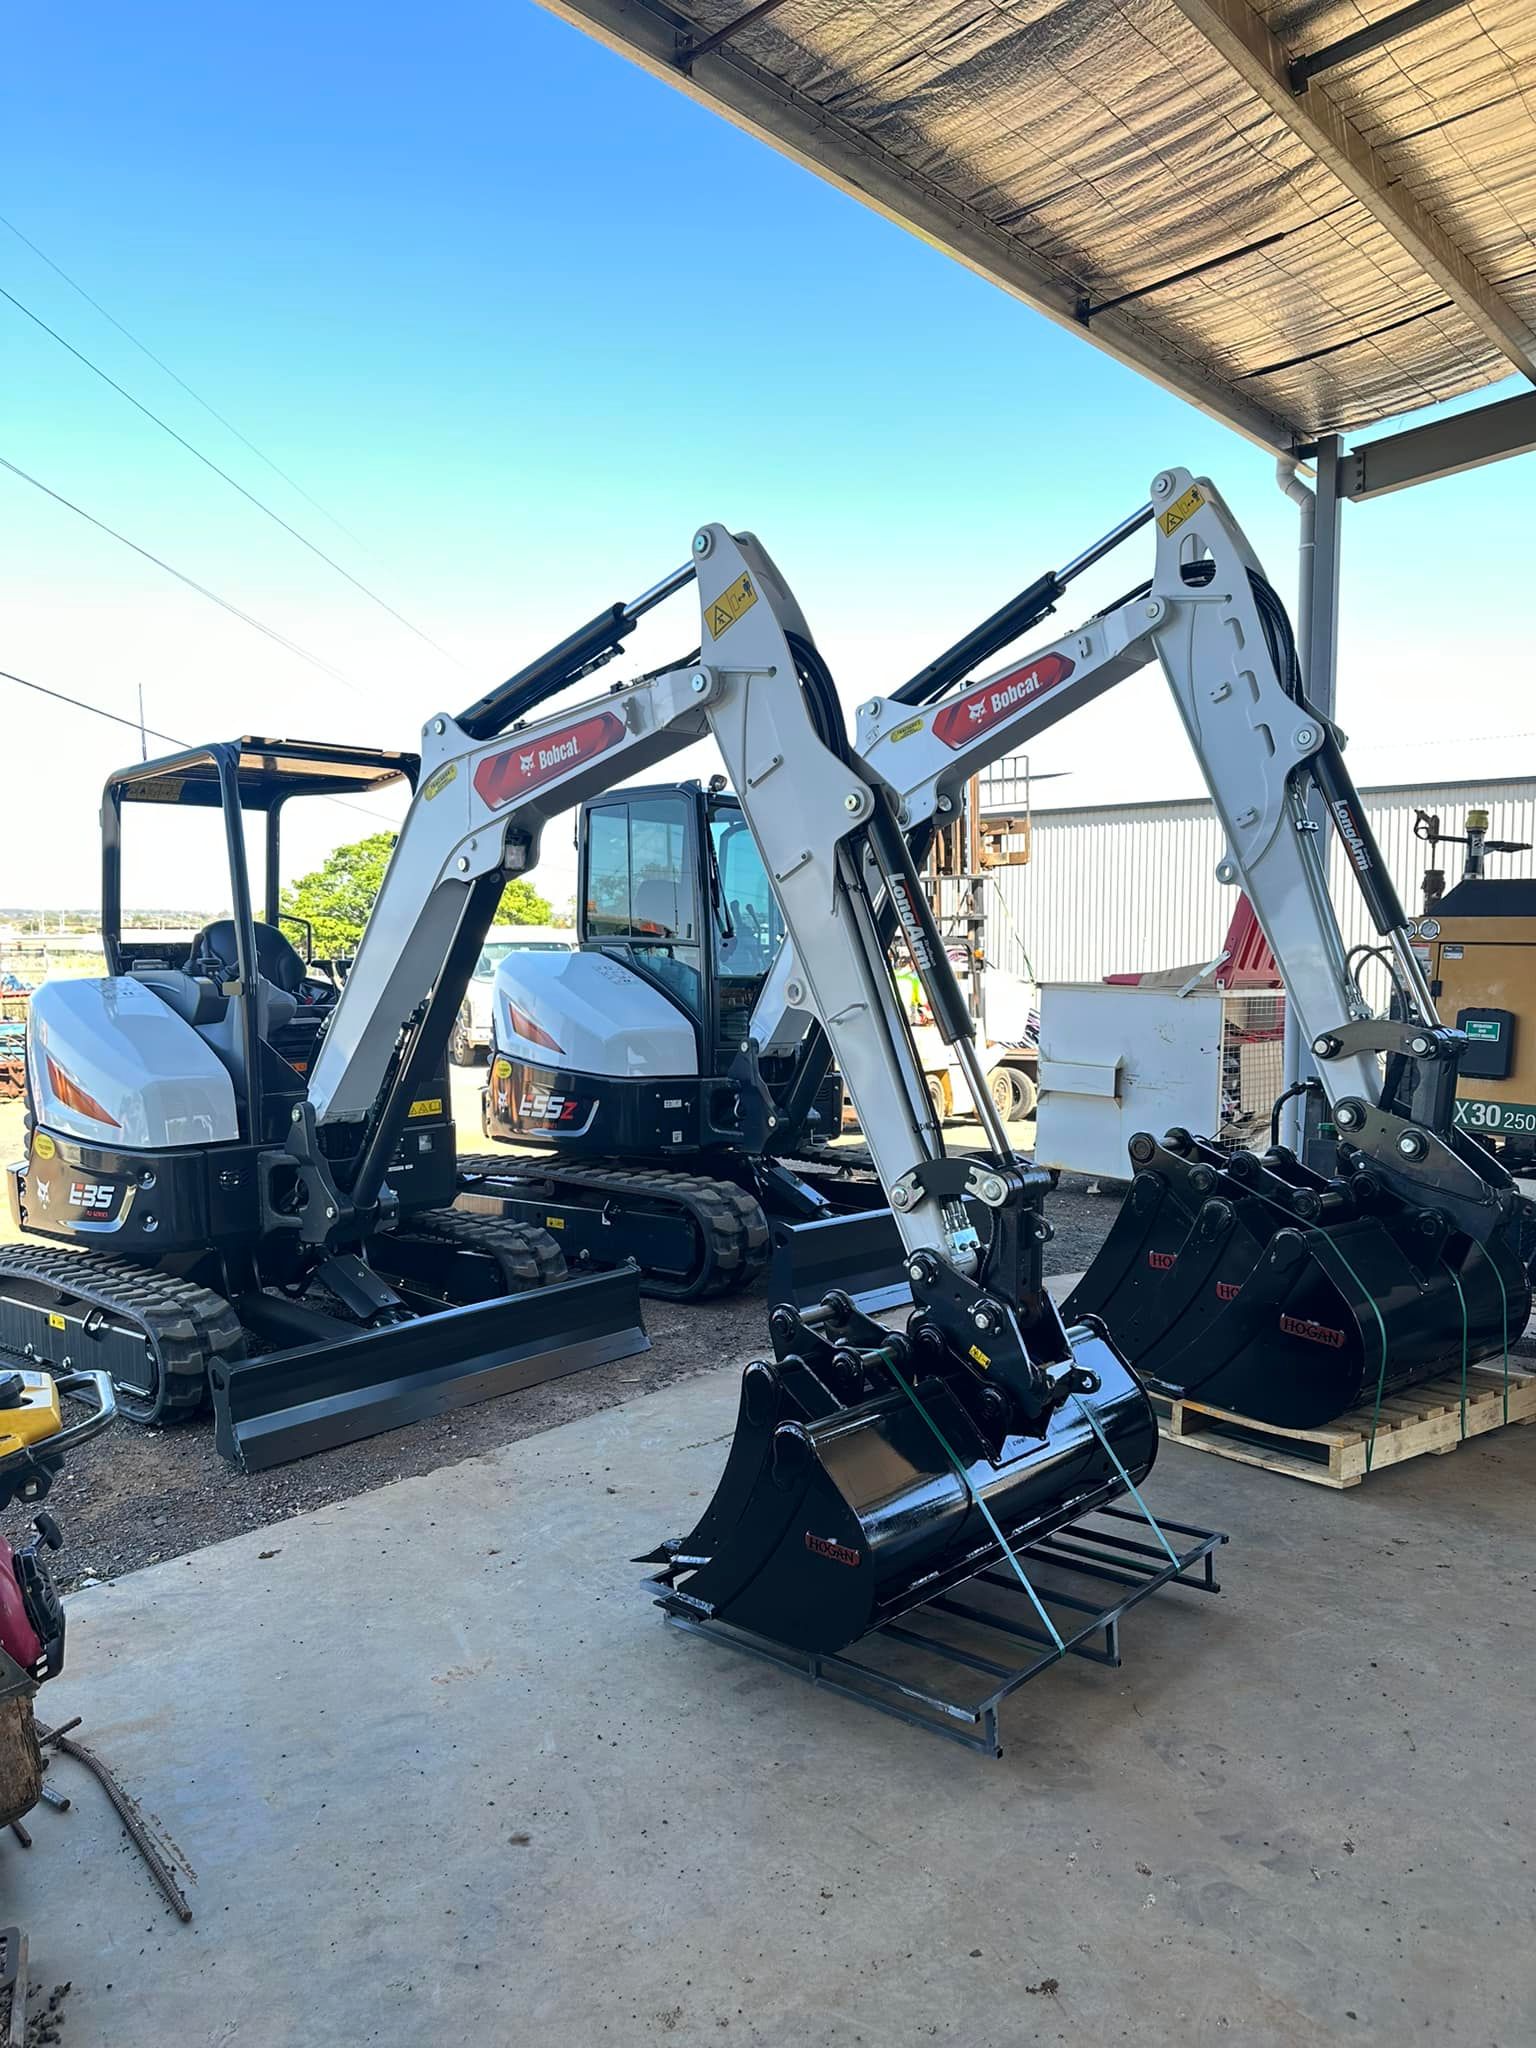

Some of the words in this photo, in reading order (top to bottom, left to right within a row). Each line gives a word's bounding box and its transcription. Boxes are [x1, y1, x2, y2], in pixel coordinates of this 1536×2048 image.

[990, 671, 1040, 713] Bobcat
[538, 735, 579, 770] Bobcat
[1331, 799, 1369, 871] LongArm
[887, 872, 932, 970] LongArm
[1503, 1112, 1536, 1131] 250
[68, 1182, 115, 1209] E35
[1152, 1254, 1173, 1268] HO
[1219, 1285, 1239, 1299] HO
[1283, 1317, 1340, 1345] HOGAN
[808, 1536, 856, 1564] HOGAN
